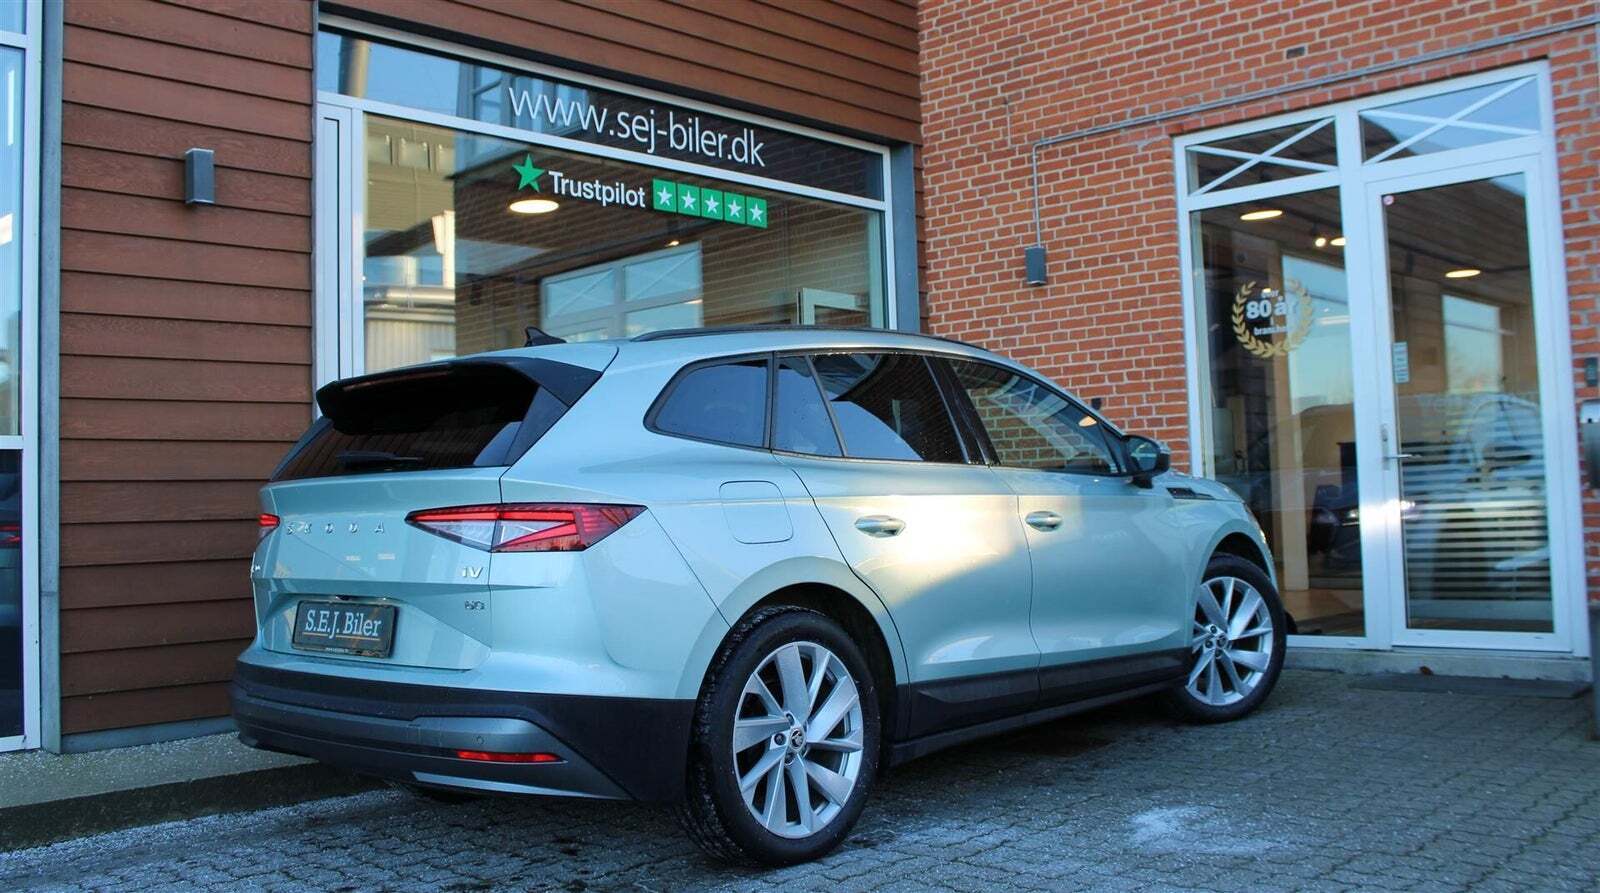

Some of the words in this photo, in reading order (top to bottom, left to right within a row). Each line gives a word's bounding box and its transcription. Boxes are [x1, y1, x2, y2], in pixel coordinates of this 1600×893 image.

[508, 86, 766, 168] www.sej-biler.dk
[548, 170, 647, 210] Trustpilot
[1245, 299, 1272, 320] 80
[304, 609, 340, 640] S.E.J.
[342, 611, 383, 637] Biler
